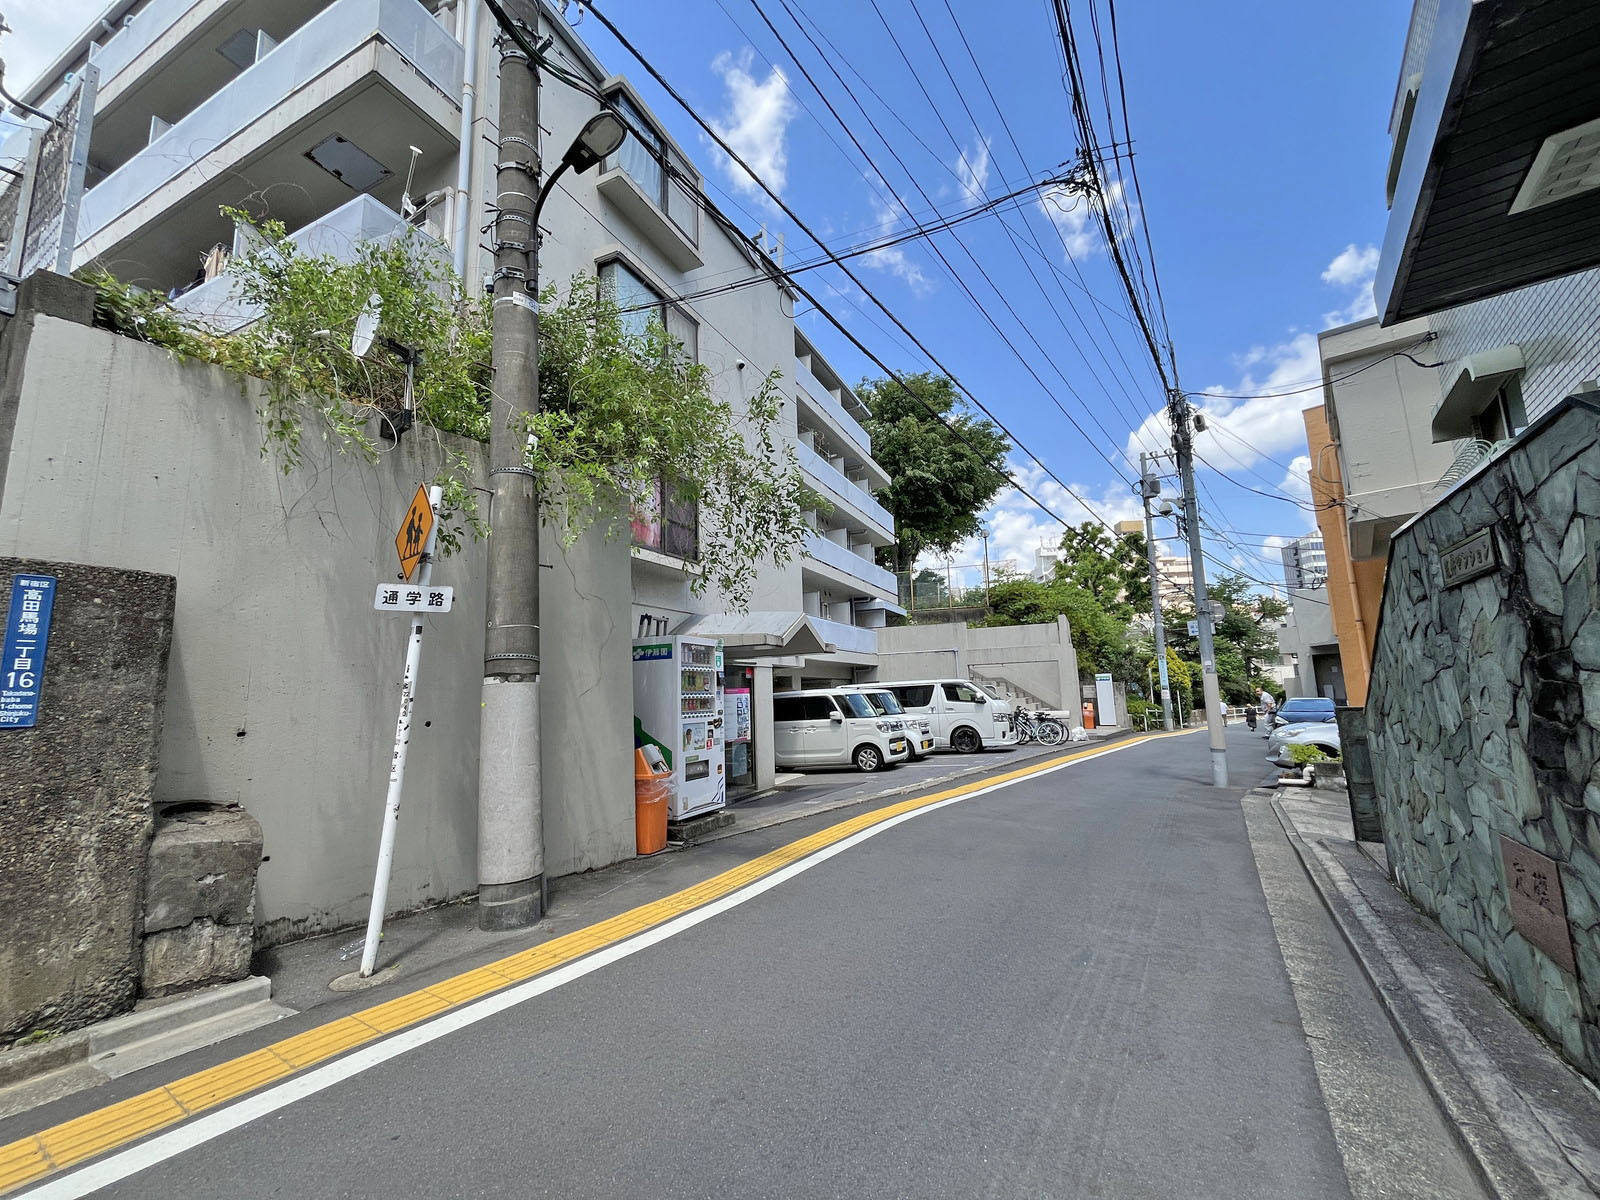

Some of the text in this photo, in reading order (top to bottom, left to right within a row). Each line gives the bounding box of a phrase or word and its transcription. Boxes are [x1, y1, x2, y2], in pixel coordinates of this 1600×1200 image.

[19, 579, 50, 588] 新宿区
[381, 590, 445, 607] 通学路
[14, 589, 44, 670] 高田馬場一丁目
[7, 671, 36, 688] 16
[0, 716, 20, 724] City
